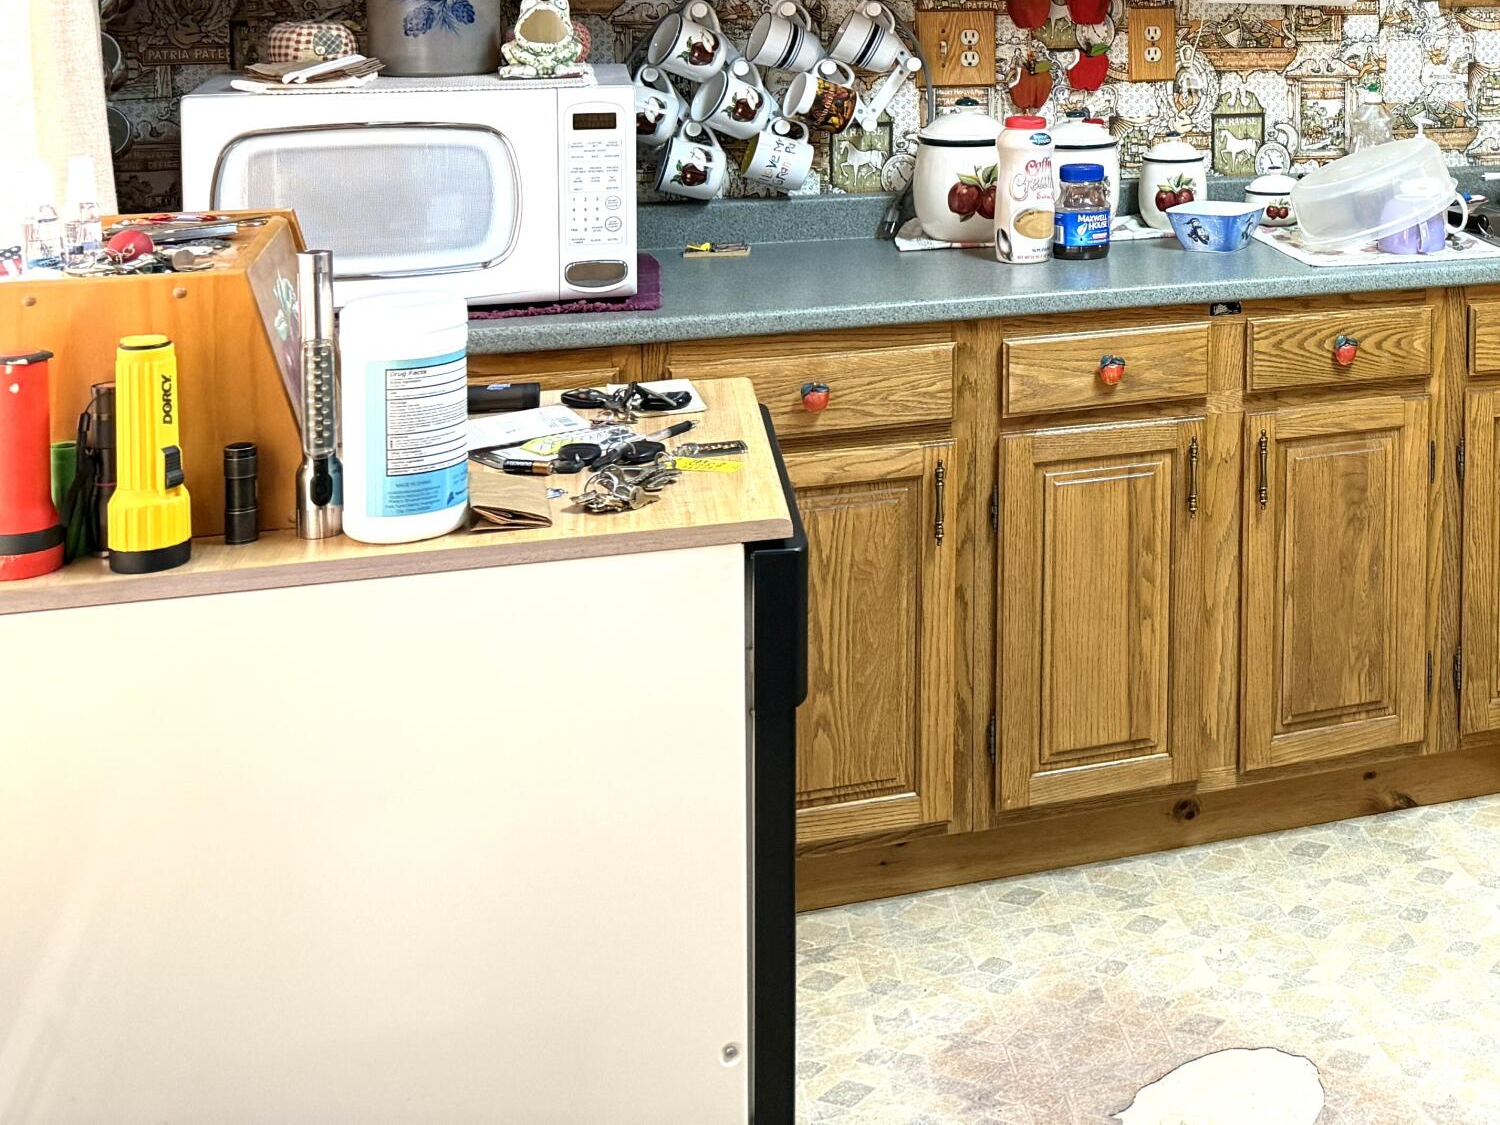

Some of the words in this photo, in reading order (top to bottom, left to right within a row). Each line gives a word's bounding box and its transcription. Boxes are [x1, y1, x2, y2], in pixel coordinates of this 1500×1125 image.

[1078, 214, 1107, 223] MAXWELL
[1088, 221, 1108, 231] HOUSE
[161, 374, 173, 425] DORCY
